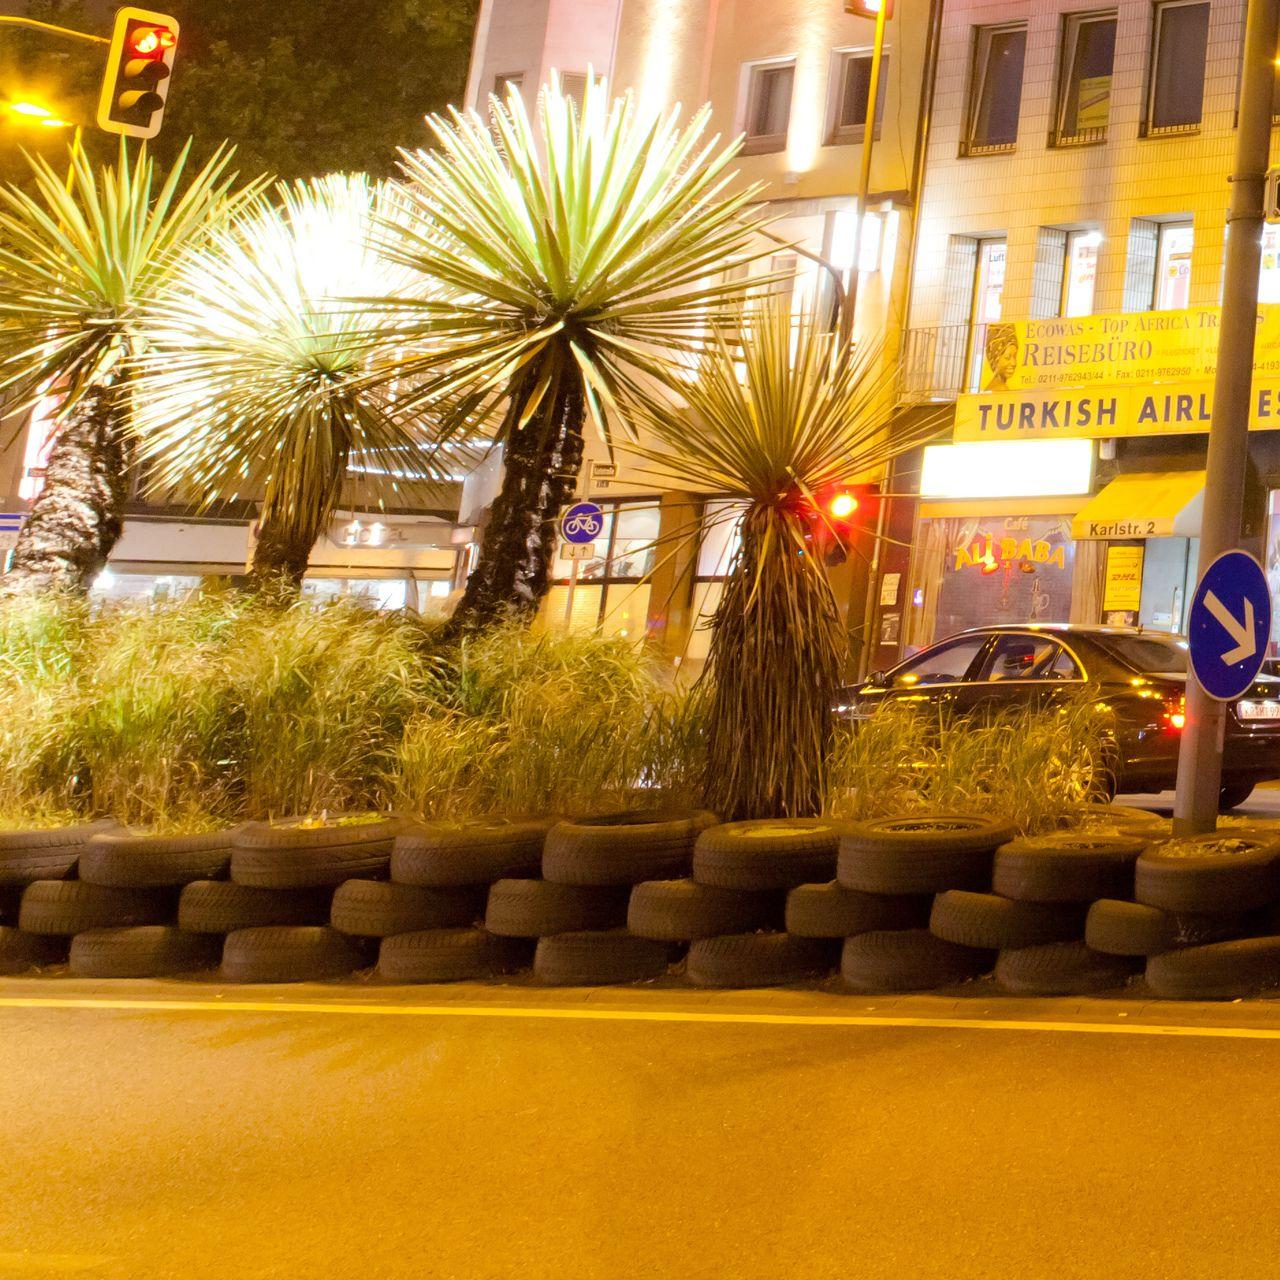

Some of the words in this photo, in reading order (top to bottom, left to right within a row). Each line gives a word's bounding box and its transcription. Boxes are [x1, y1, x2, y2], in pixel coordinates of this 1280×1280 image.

[1026, 323, 1084, 339] ECOWAS
[1100, 318, 1129, 334] TOP
[1134, 314, 1190, 332] AFRICA
[1021, 336, 1153, 367] REISEBÜRO
[979, 398, 1117, 431] TURKISH
[1089, 522, 1143, 536] Karlstr.
[1147, 521, 1156, 535] 2
[1001, 537, 1065, 570] BABA
